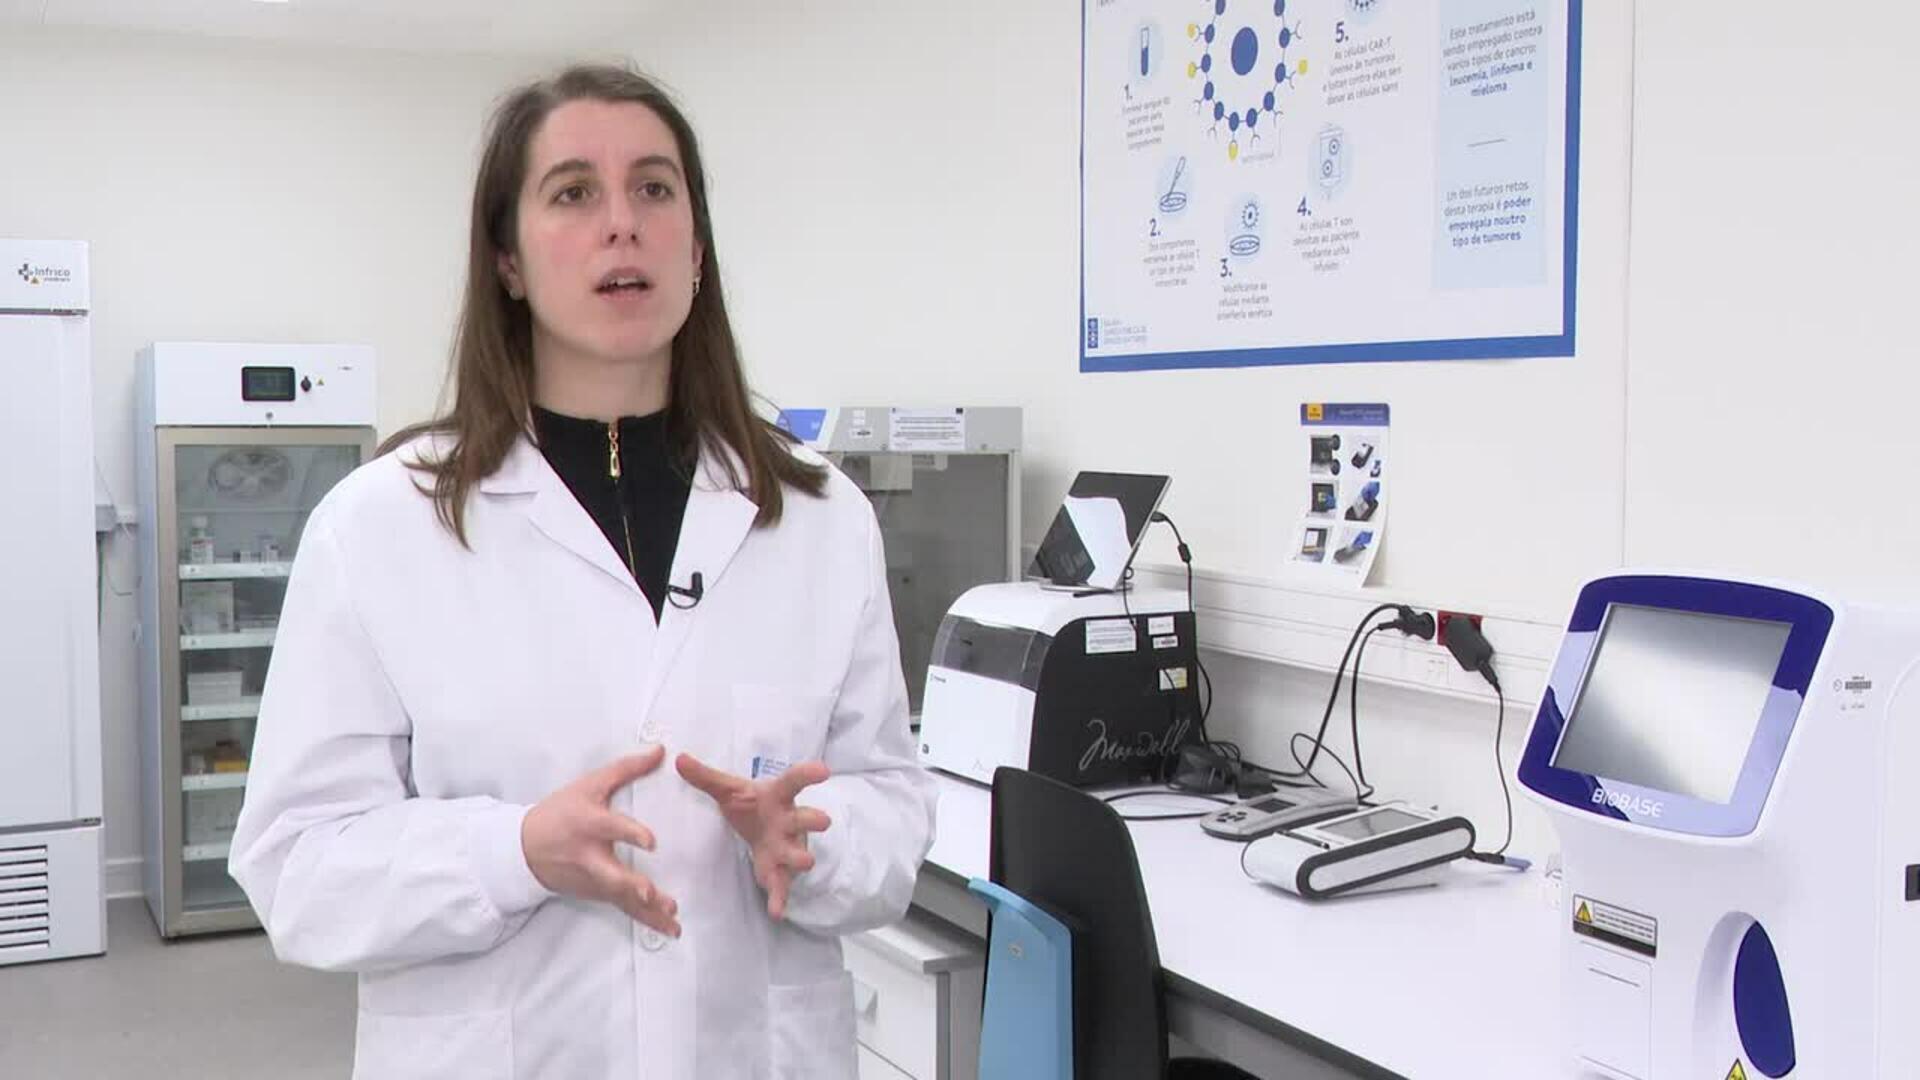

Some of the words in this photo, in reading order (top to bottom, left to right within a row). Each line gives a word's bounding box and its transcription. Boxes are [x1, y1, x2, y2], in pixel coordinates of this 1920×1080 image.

[1468, 15, 1514, 35] tratamento
[1516, 9, 1535, 23] está
[1335, 21, 1349, 43] 5.
[1467, 32, 1512, 52] empregado
[1513, 25, 1542, 40] contra
[1472, 53, 1492, 67] tipos
[1493, 49, 1504, 61] de
[1490, 62, 1524, 78] linfoma
[1526, 60, 1533, 70] e
[1123, 84, 1133, 101] 1.
[1470, 81, 1508, 97] mieloma
[1474, 184, 1504, 197] futuros
[1505, 181, 1529, 193] retos
[1296, 196, 1312, 216] 4.
[1467, 200, 1494, 214] terapia
[1503, 196, 1531, 210] poder
[1149, 218, 1161, 237] 2.
[1493, 213, 1527, 226] noutro
[1452, 235, 1469, 247] tipo
[1470, 232, 1481, 245] de
[1482, 231, 1521, 244] tumores
[1220, 257, 1232, 278] 3.
[1079, 717, 1190, 770] Maxwell
[1591, 787, 1665, 818] BIOBASE
